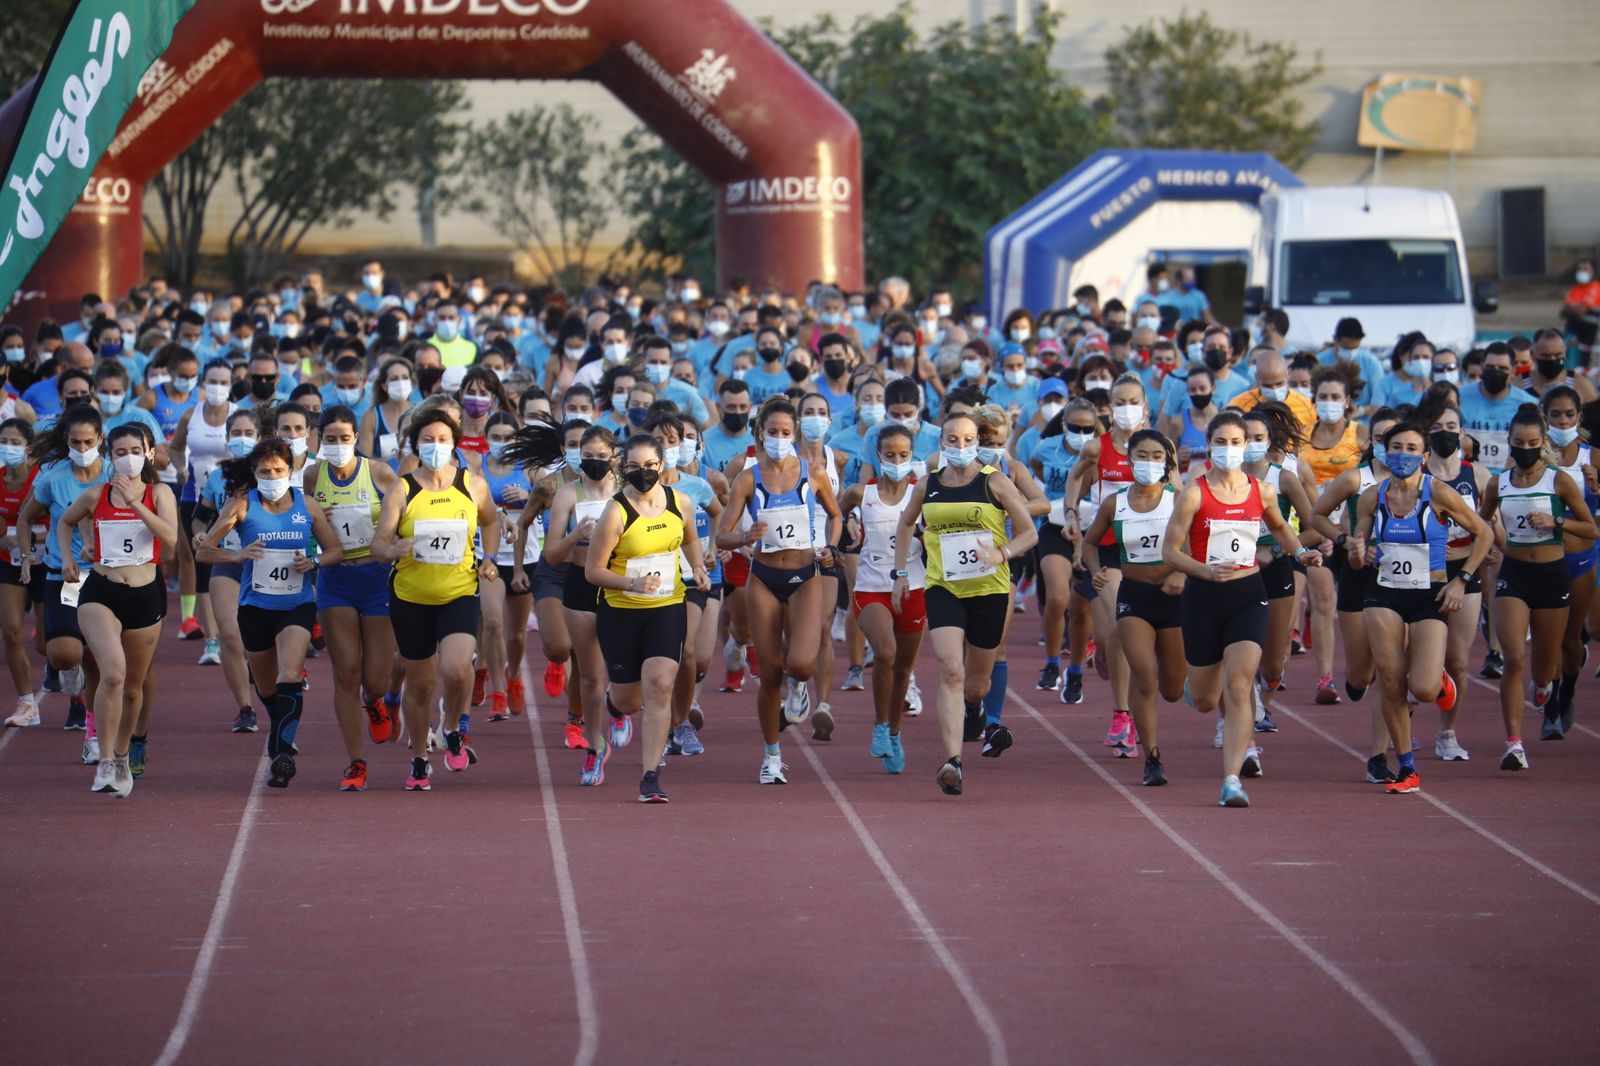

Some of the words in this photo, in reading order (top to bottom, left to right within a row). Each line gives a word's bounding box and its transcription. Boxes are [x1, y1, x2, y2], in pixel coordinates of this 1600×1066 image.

[263, 22, 330, 38] Instituto
[334, 22, 414, 42] Municipal
[418, 24, 439, 40] de
[442, 24, 516, 42] Deportes
[520, 23, 589, 41] Córdoba
[107, 90, 178, 159] AYUNTAMIENTO
[172, 76, 192, 98] DE
[749, 176, 851, 202] IMDECO
[1090, 176, 1152, 228] PUESTO
[1157, 169, 1230, 186] MEDICO
[257, 531, 304, 541] TROTASIERRA
[342, 522, 350, 537] 1
[776, 524, 795, 539] 12
[123, 538, 133, 553] 5
[430, 537, 451, 550] 47
[1140, 534, 1159, 548] 27
[1231, 538, 1240, 552] 6
[958, 549, 978, 565] 33
[269, 567, 289, 581] 40
[1392, 561, 1412, 575] 20
